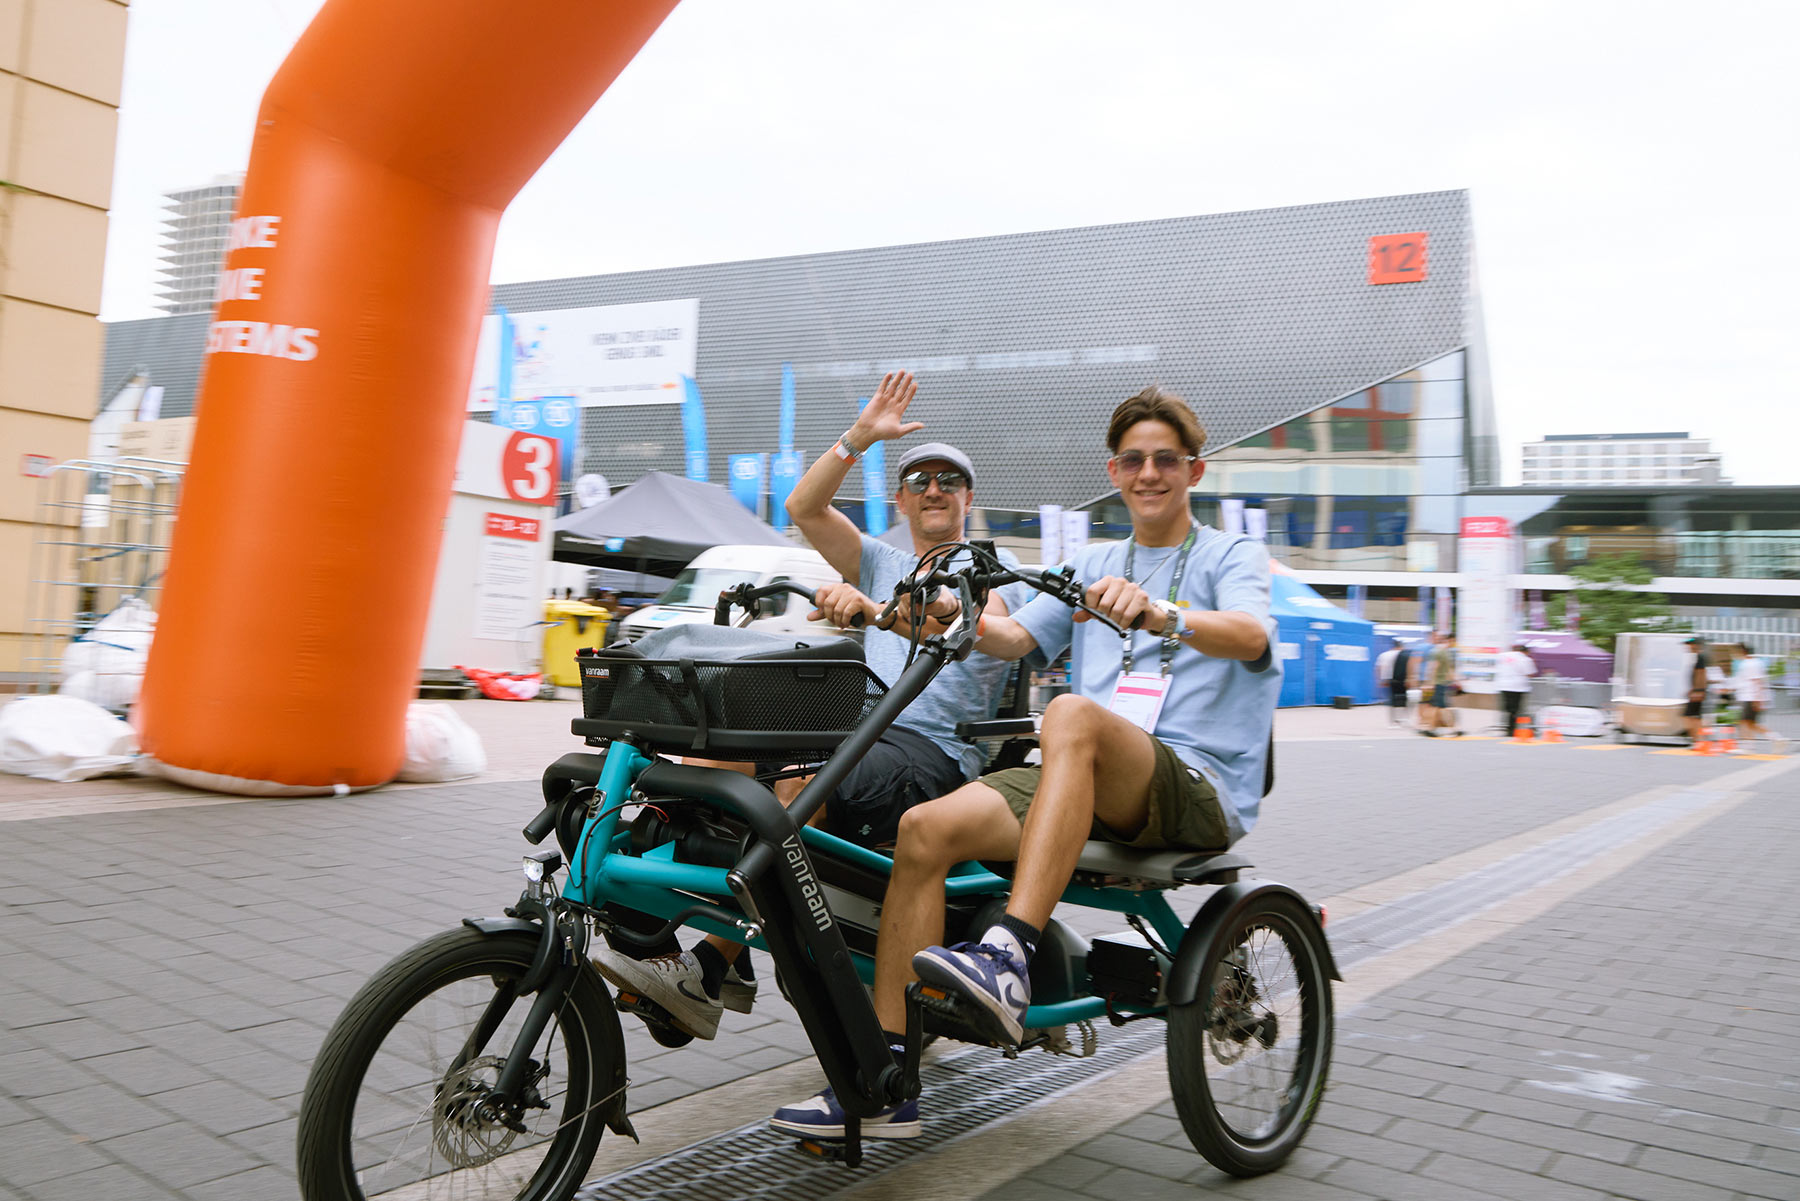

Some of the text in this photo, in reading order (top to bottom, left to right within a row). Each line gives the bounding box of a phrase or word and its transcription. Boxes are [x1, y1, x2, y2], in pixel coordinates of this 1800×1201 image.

[1376, 242, 1420, 273] 12
[512, 437, 553, 499] 3
[585, 667, 609, 676] vanraam
[781, 834, 832, 932] vanraam
